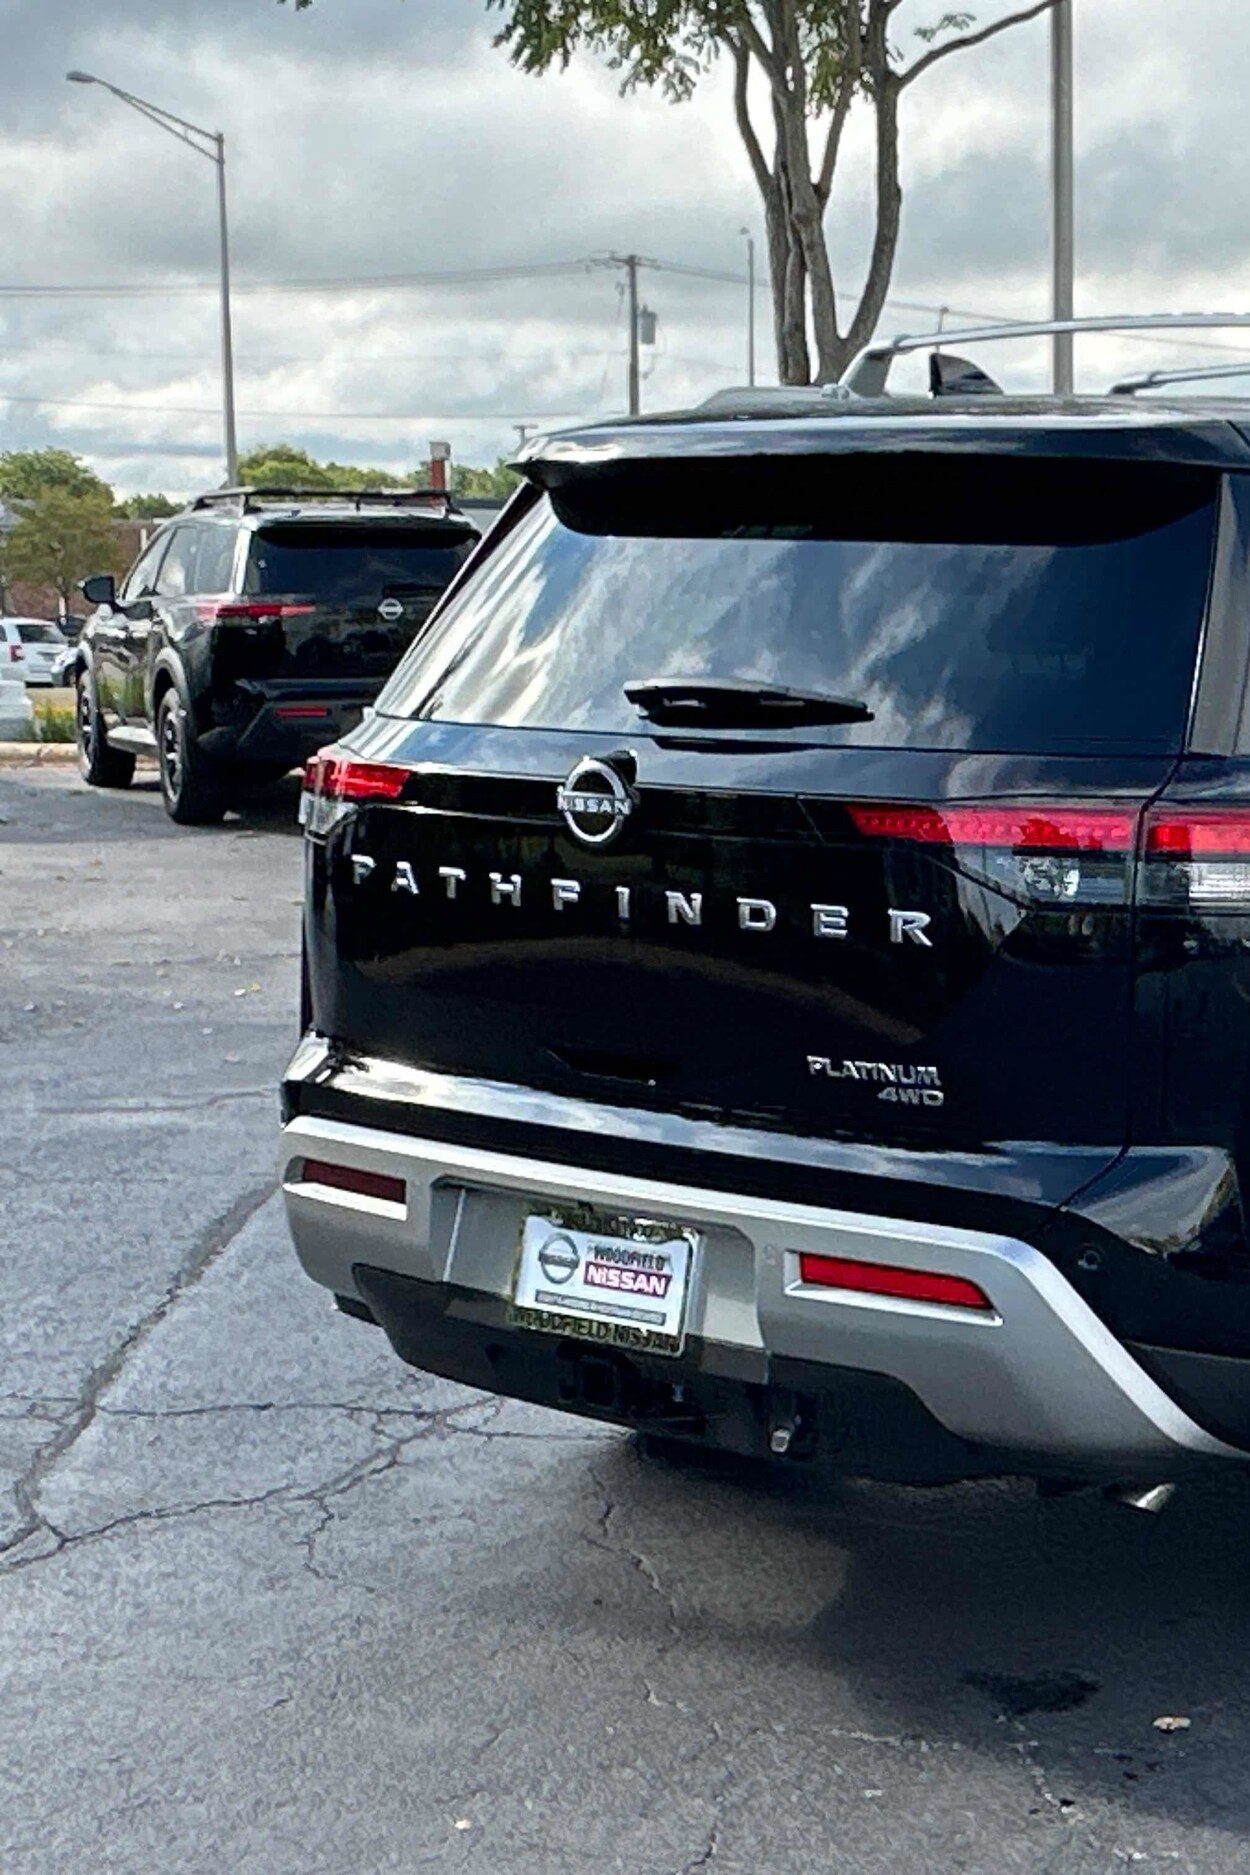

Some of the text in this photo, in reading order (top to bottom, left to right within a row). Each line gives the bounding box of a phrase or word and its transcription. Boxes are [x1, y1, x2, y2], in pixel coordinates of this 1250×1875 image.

[557, 796, 632, 816] NISSAN
[351, 854, 933, 947] PATHFINDER
[806, 1055, 943, 1086] PLATINUM
[877, 1086, 945, 1107] 4WD
[586, 1263, 667, 1297] NISSAN
